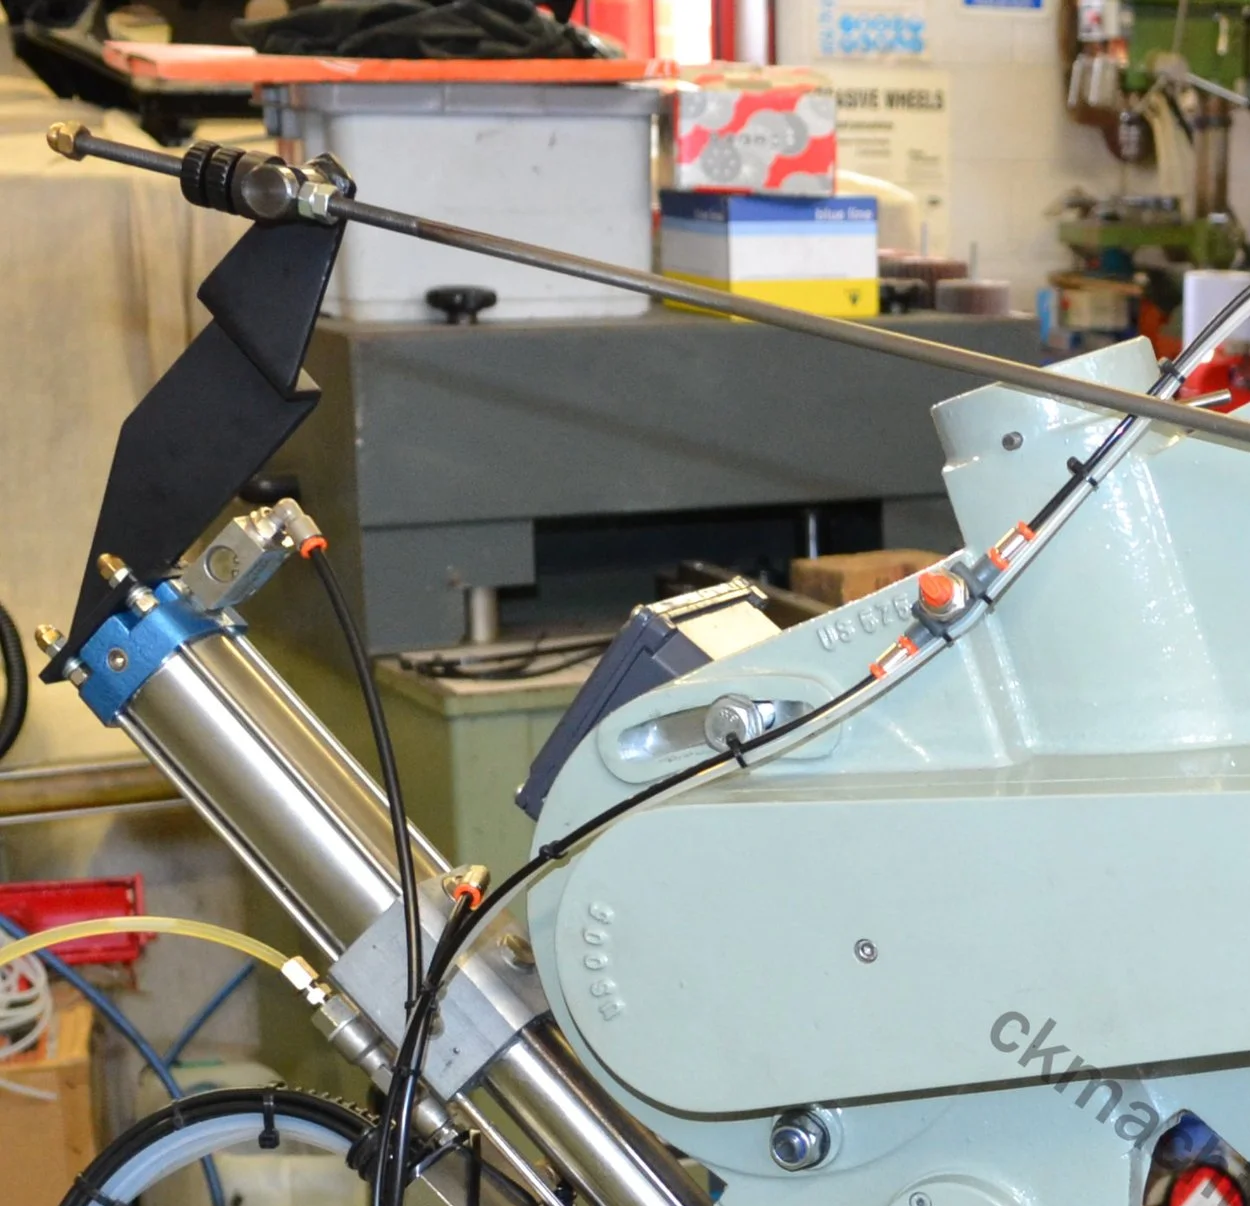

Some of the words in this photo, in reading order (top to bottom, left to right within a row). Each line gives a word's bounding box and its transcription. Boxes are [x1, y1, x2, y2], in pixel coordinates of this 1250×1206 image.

[885, 88, 945, 109] WHEELS
[814, 206, 844, 221] blue
[847, 206, 872, 221] line
